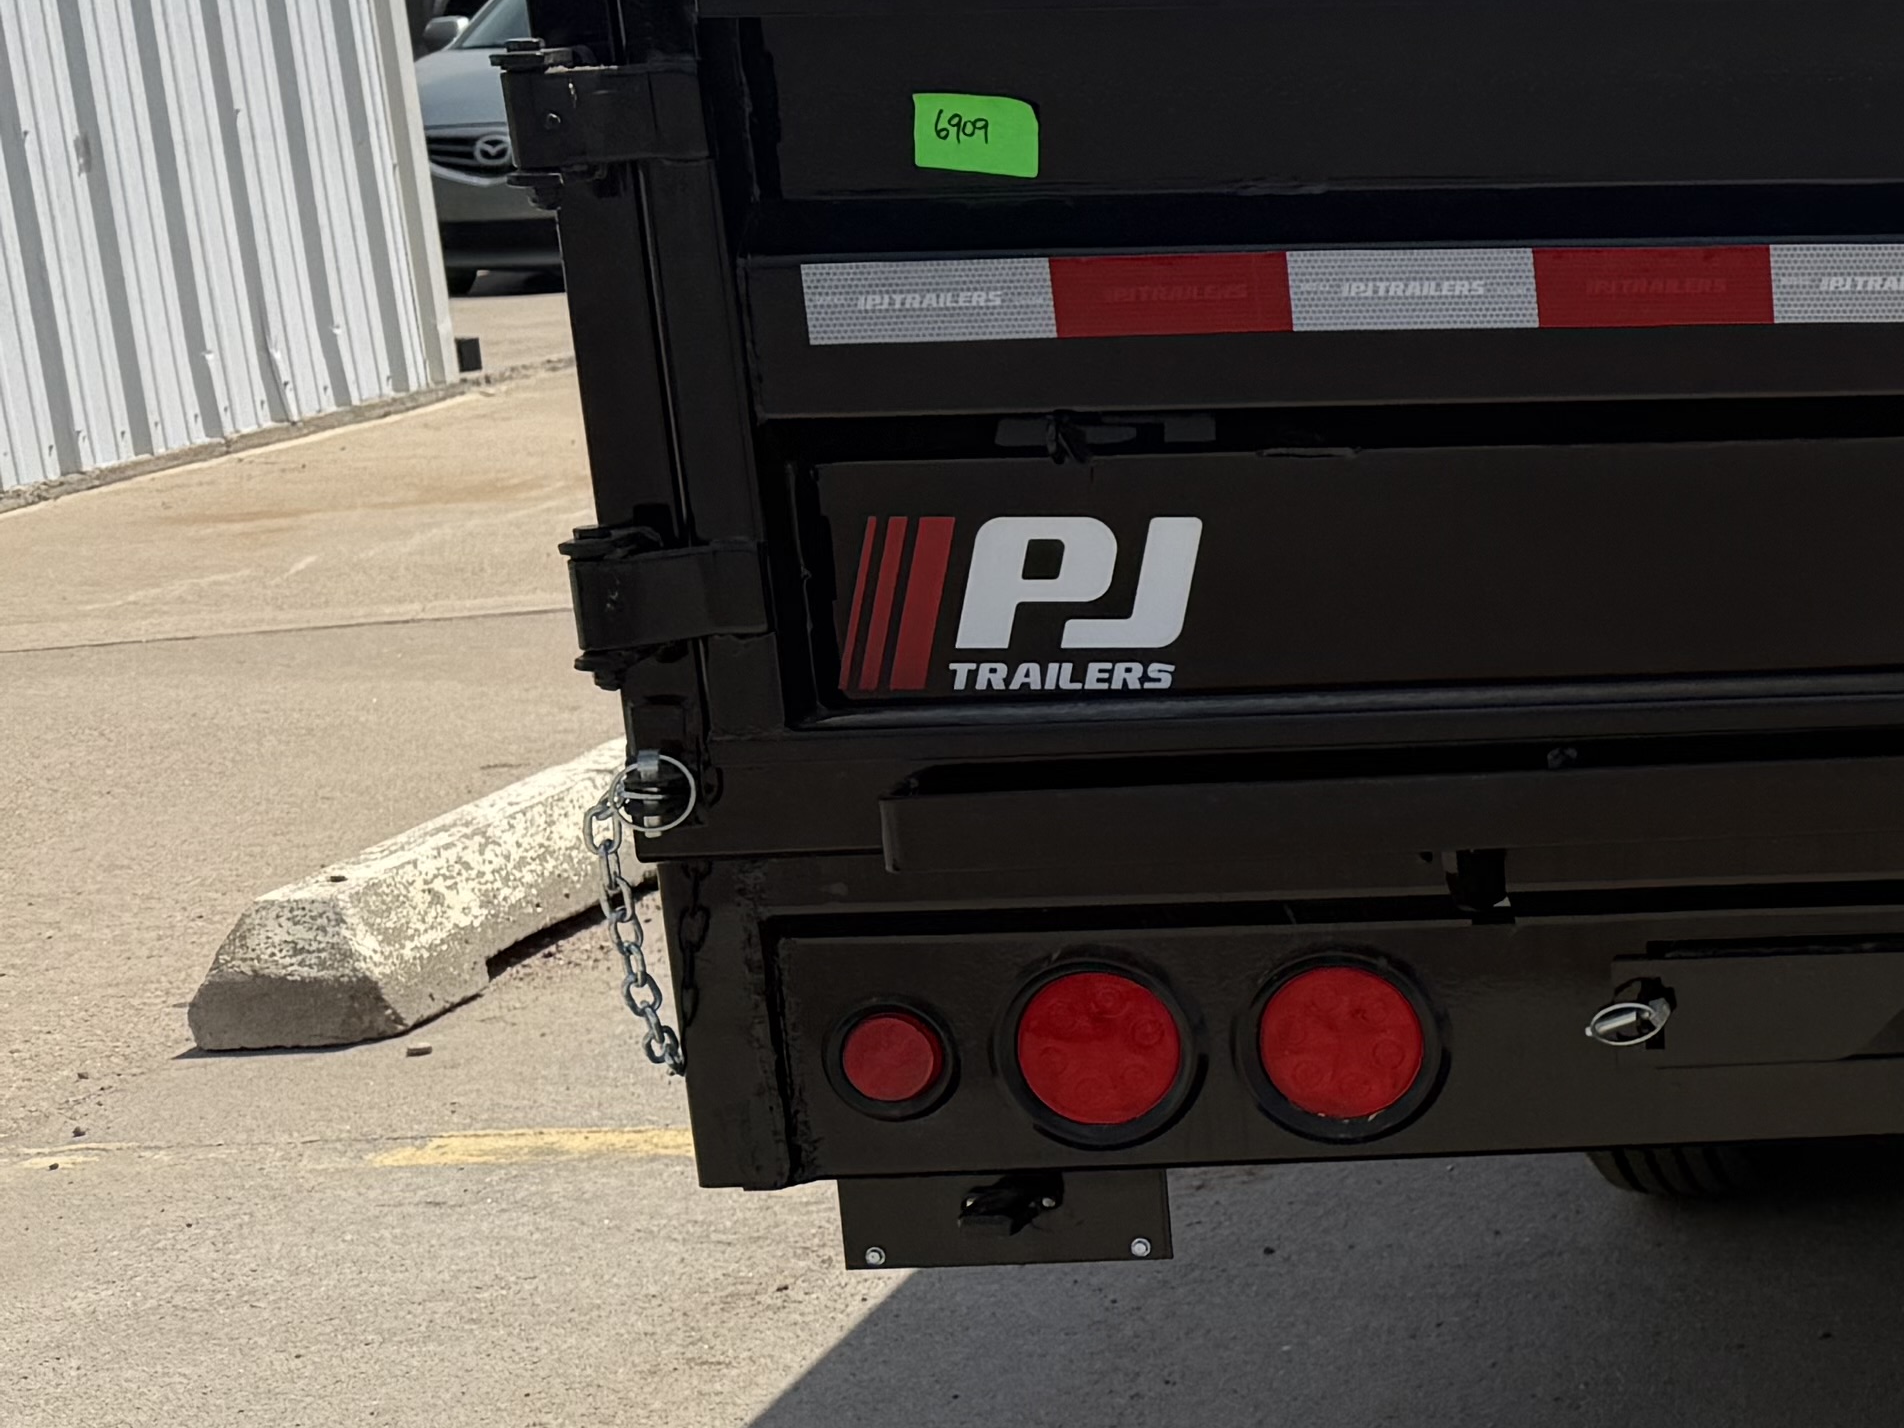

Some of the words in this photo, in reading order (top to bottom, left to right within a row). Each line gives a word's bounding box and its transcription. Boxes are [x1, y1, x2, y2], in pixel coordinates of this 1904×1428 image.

[934, 108, 989, 145] 6909
[956, 516, 1203, 649] PJ
[948, 662, 1176, 690] TRAILERS
